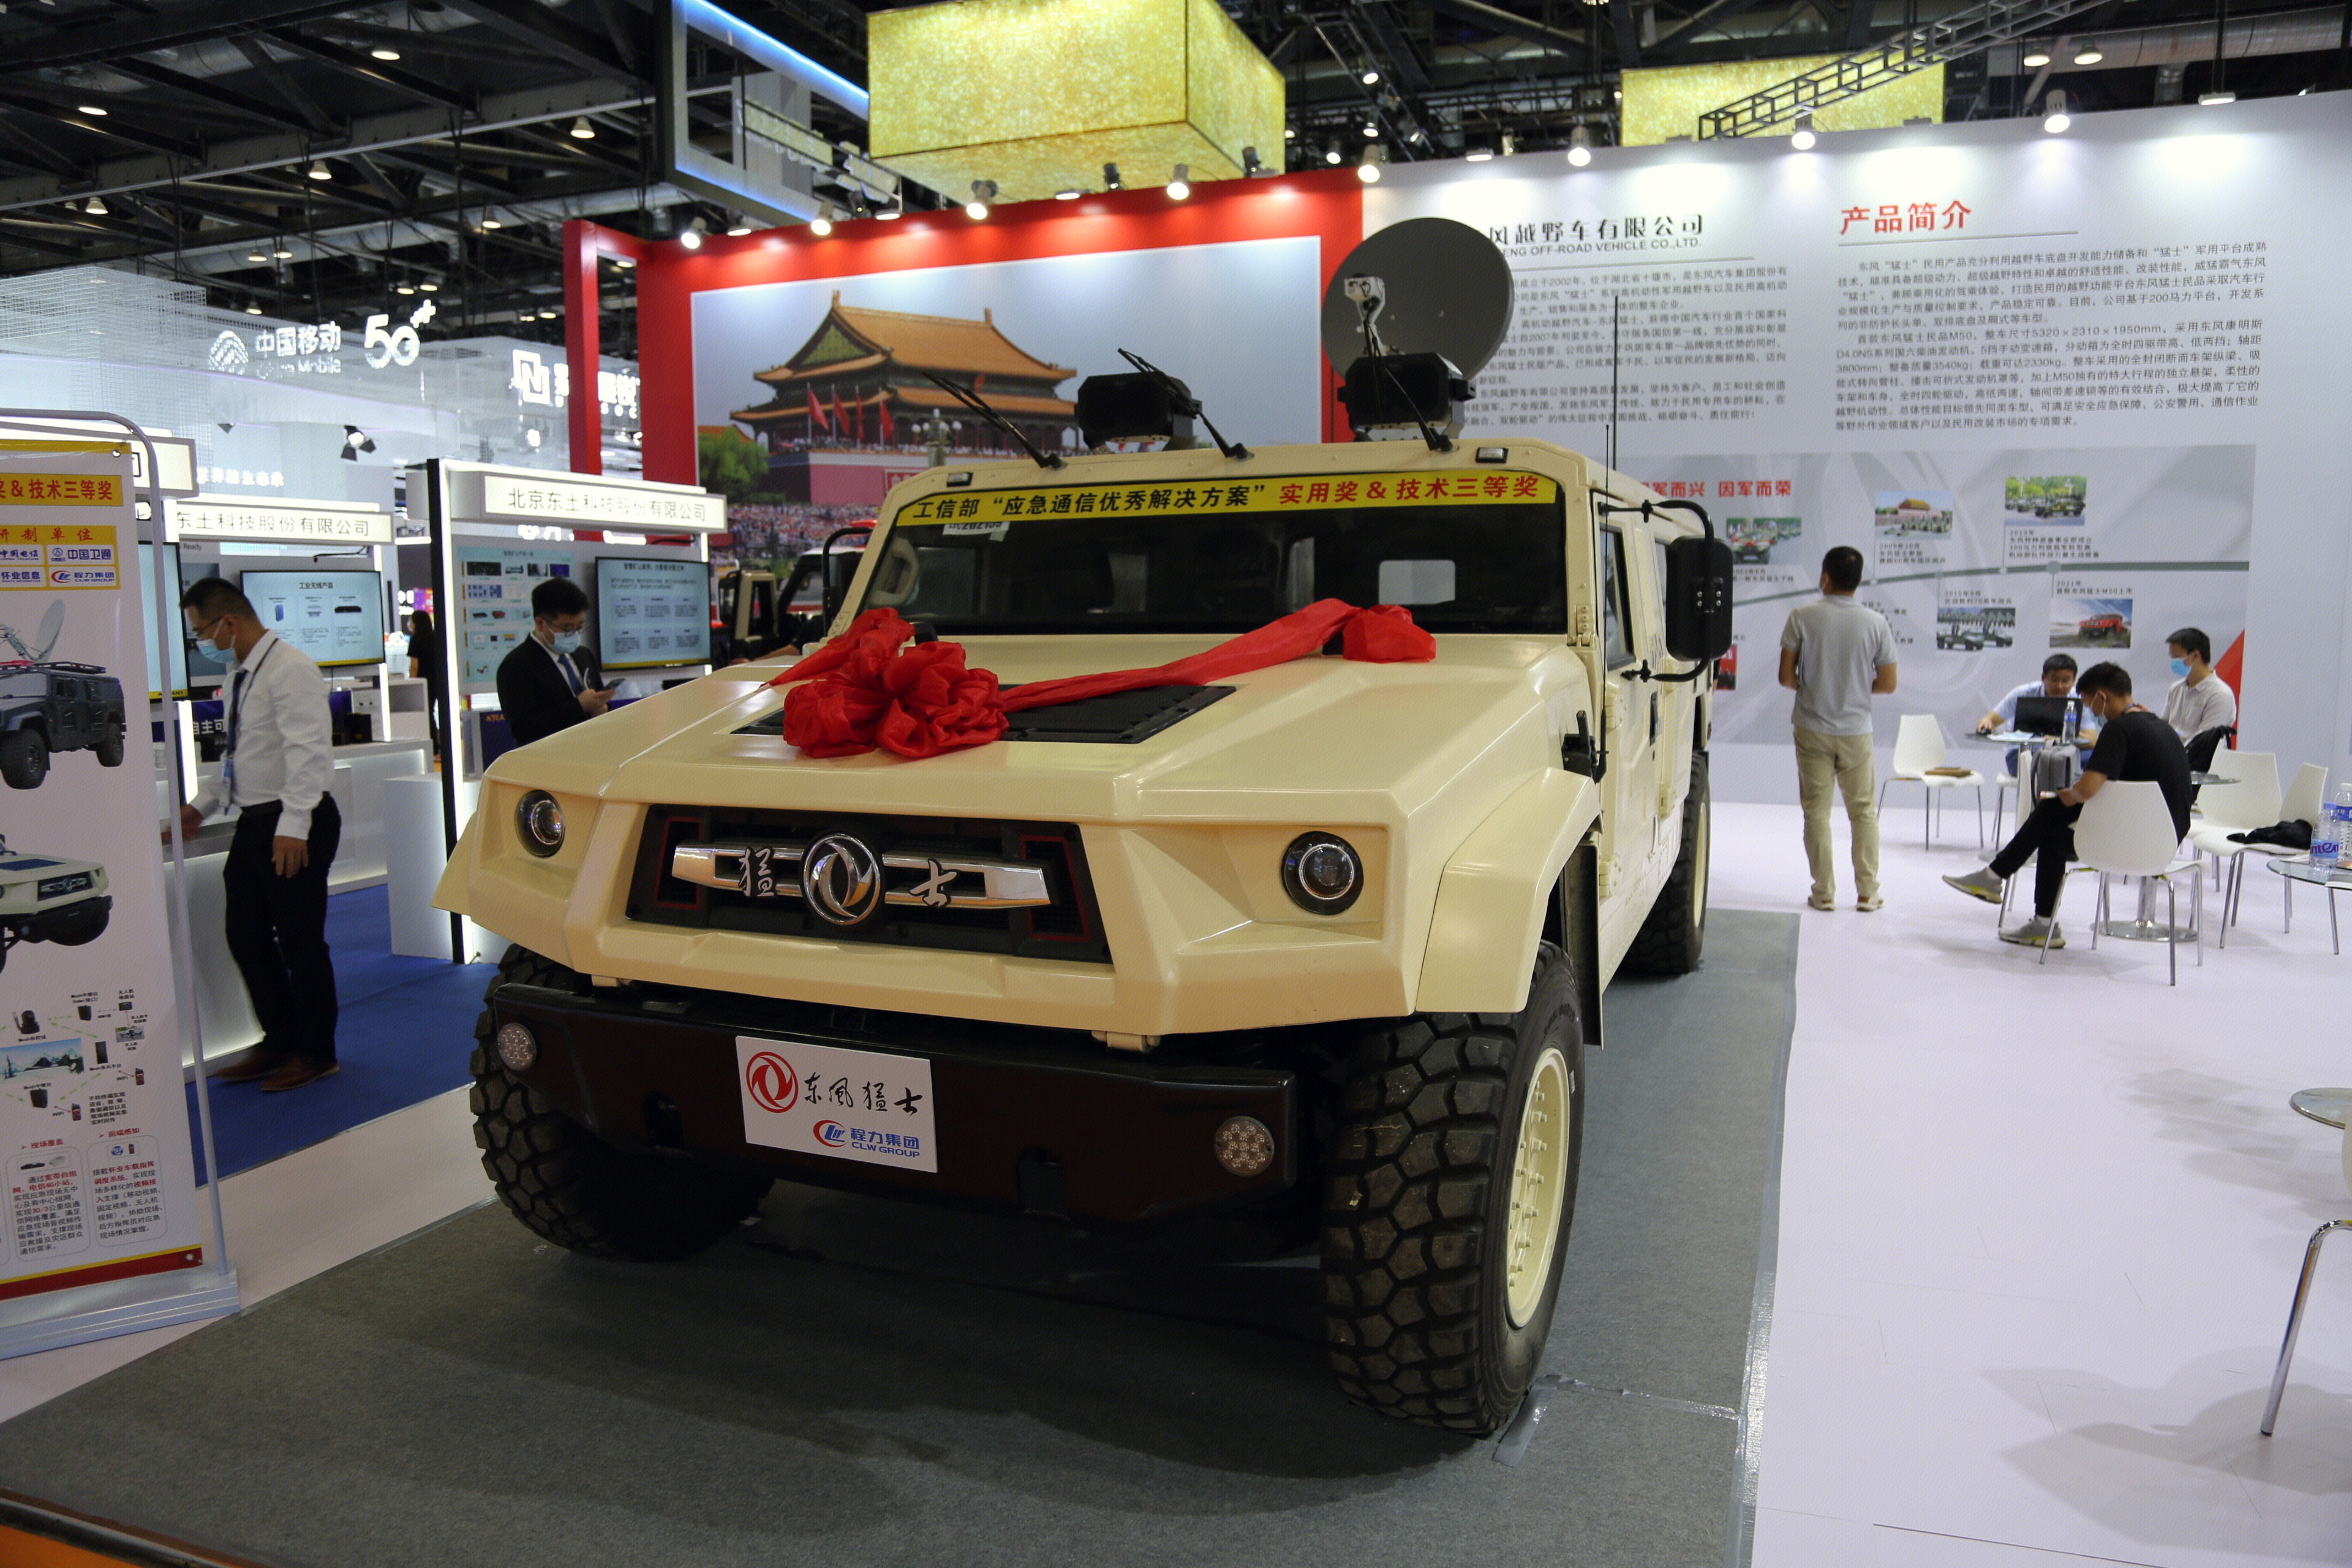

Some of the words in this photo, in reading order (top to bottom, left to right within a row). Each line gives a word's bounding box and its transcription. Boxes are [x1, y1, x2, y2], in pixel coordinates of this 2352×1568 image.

[1840, 200, 1972, 235] 产品简介
[1531, 243, 1593, 255] OFF-ROAD
[1597, 239, 1648, 252] VEHICLE
[256, 322, 341, 358] 中国移动
[1719, 480, 1792, 497] 因军而荣
[508, 488, 706, 522] 北京东土科技股份有限公司
[177, 511, 369, 537] 东土科技股份有限公司
[67, 549, 111, 560] 中国卫通
[108, 1128, 140, 1138] 前端感知
[850, 1127, 920, 1150] 程力集团
[31, 1138, 64, 1149] 现场覆盖
[851, 1142, 877, 1152] CLW
[878, 1146, 921, 1158] GROUP
